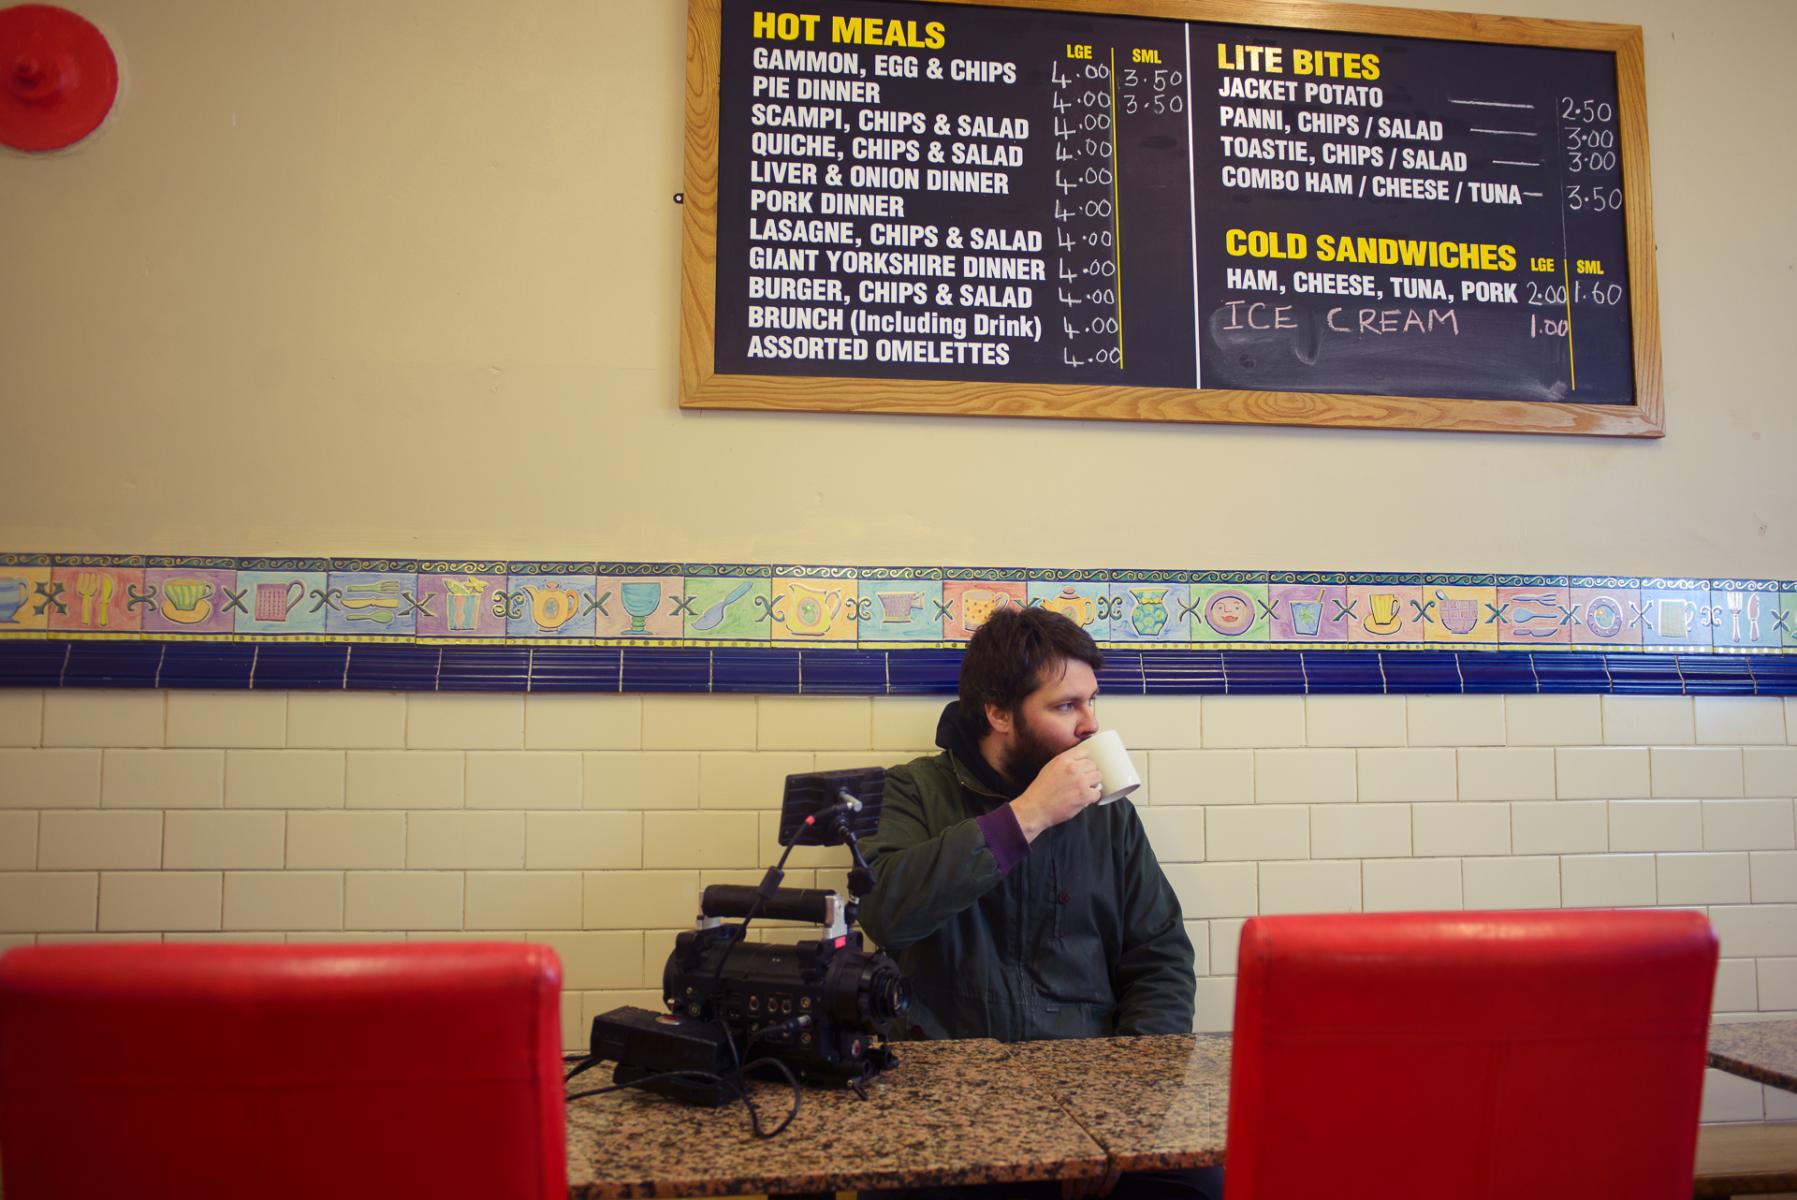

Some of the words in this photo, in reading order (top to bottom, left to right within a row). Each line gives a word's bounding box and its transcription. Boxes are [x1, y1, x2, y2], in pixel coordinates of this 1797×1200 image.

[753, 12, 820, 42] HOT
[832, 16, 946, 49] MEALS
[1067, 44, 1092, 59] LGE
[1132, 49, 1162, 64] SML
[1217, 43, 1283, 74] LITE
[1293, 50, 1381, 80] BITES
[753, 48, 868, 79] GAMMON,
[875, 55, 918, 78] EGG
[926, 57, 944, 80] &
[950, 59, 1017, 84] CHIPS
[1052, 60, 1109, 88] 4.00
[752, 76, 791, 98] PIE
[797, 79, 880, 104] DINNER
[1124, 69, 1182, 91] 3.50
[1218, 77, 1299, 102] JACKET
[1305, 83, 1383, 108] POTATO
[1053, 91, 1111, 114] 4.00
[1124, 95, 1183, 114] 3.50
[1561, 96, 1612, 123] 2.50
[751, 104, 851, 134] SCAMPI,
[858, 108, 926, 134] CHIPS
[934, 112, 951, 136] &
[957, 114, 1029, 140] SALAD
[1054, 114, 1111, 140] 4.00
[1220, 106, 1292, 134] PANNI,
[1298, 111, 1359, 136] CHIPS
[1365, 117, 1373, 138] /
[1378, 117, 1443, 141] SALAD
[751, 132, 844, 161] QUICHE,
[852, 137, 918, 162] CHIPS
[928, 140, 945, 163] &
[951, 142, 1024, 168] SALAD
[1056, 139, 1113, 161] 4.00
[1564, 127, 1614, 150] 3.00
[1221, 136, 1316, 166] TOASTIE,
[1322, 142, 1384, 168] CHIPS
[1389, 148, 1398, 169] /
[1402, 148, 1468, 172] SALAD
[1568, 151, 1616, 172] 3.00
[751, 161, 818, 185] LIVER
[825, 164, 842, 186] &
[850, 166, 921, 190] ONION
[926, 169, 1009, 195] DINNER
[1056, 167, 1113, 195] 4.00
[1222, 166, 1299, 191] COMBO
[1305, 172, 1353, 196] HAM
[1359, 176, 1367, 196] /
[1372, 175, 1450, 201] CHEESE
[1455, 182, 1463, 202] /
[1468, 182, 1522, 205] TUNA
[750, 189, 814, 214] PORK
[820, 192, 904, 218] DINNER
[1054, 199, 1112, 222] 4.00
[1566, 185, 1622, 211] 3.50
[749, 218, 862, 248] LASAGNE,
[869, 223, 939, 249] CHIPS
[946, 227, 963, 250] &
[971, 227, 1042, 252] SALAD
[1057, 227, 1111, 251] 4.00
[1225, 228, 1308, 260] COLD
[1316, 236, 1517, 272] SANDWICHES
[749, 246, 819, 271] GIANT
[827, 250, 956, 278] YORKSHIRE
[963, 255, 1046, 282] DINNER
[1059, 257, 1115, 284] 4.00
[1530, 257, 1555, 272] LGE
[1577, 259, 1604, 275] SML
[748, 276, 851, 306] BURGER,
[859, 281, 929, 306] CHIPS
[935, 284, 954, 306] &
[960, 284, 1033, 309] SALAD
[1059, 287, 1115, 307] 4.00
[1226, 267, 1286, 296] HAM,
[1293, 270, 1383, 300] CHEESE,
[1390, 276, 1454, 303] TUNA,
[1461, 280, 1518, 304] PORK
[1526, 281, 1567, 306] 2.00
[1575, 280, 1622, 305] 1.60
[748, 306, 843, 331] BRUNCH
[850, 309, 968, 339] (Including
[974, 312, 1042, 342] Drink)
[1064, 316, 1118, 340] 4.00
[1221, 299, 1299, 331] ICE
[1325, 307, 1460, 336] CREAM
[1530, 313, 1569, 338] 1.00
[747, 335, 869, 362] ASSORTED
[875, 338, 1010, 366] OMELETTES
[1064, 347, 1122, 368] 4.00
